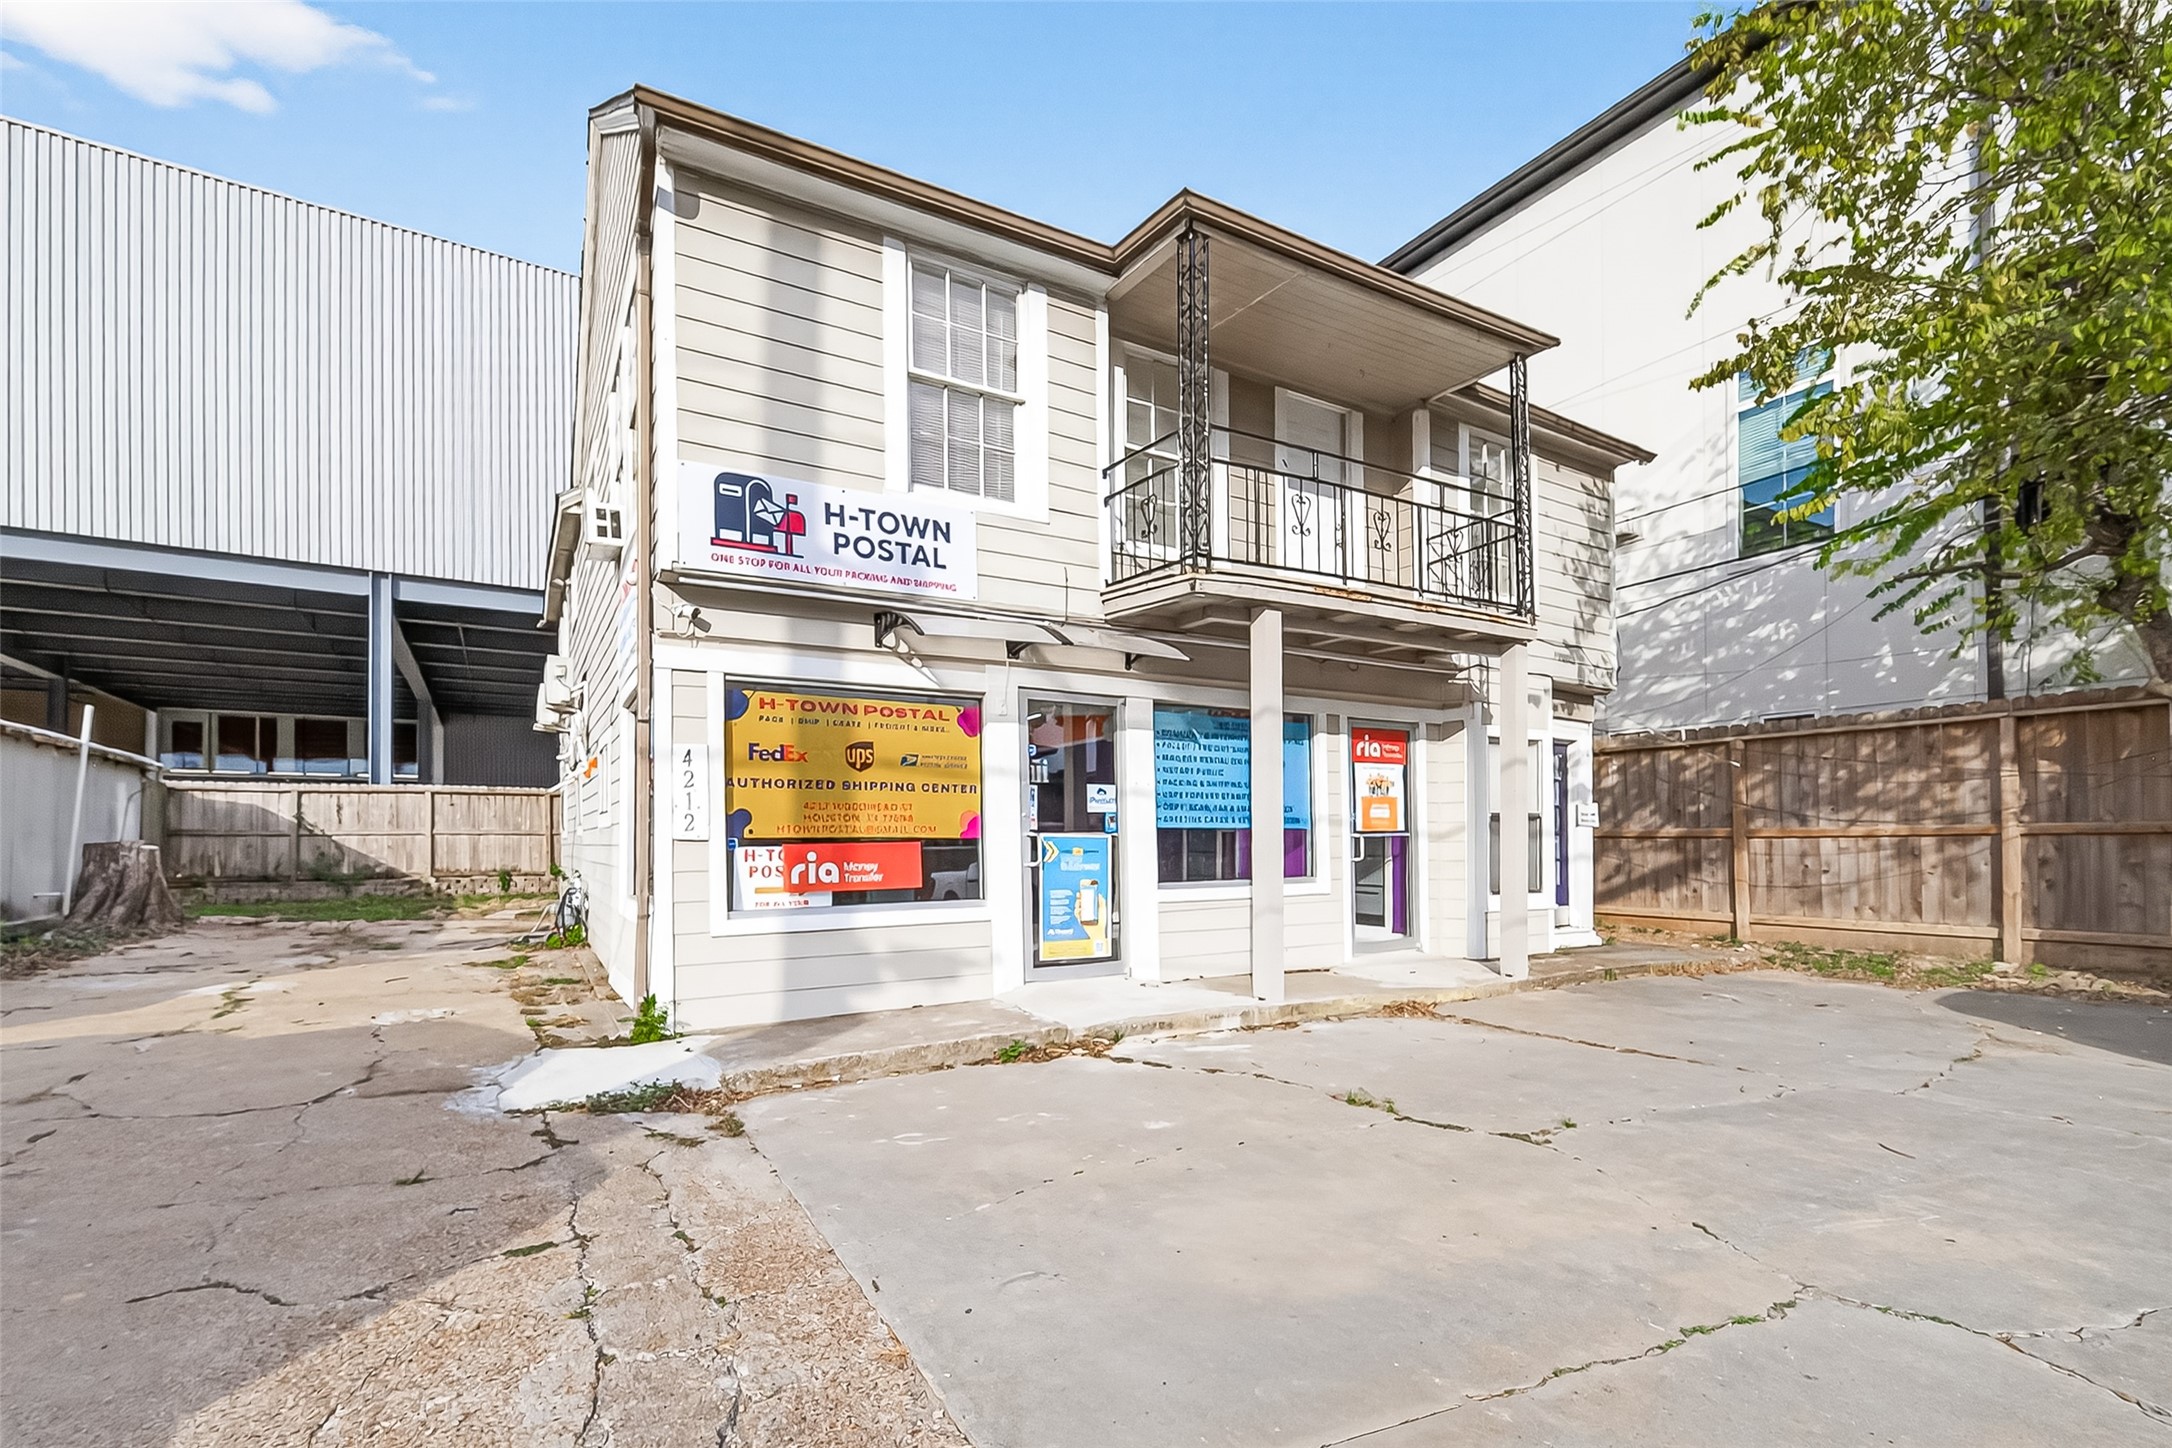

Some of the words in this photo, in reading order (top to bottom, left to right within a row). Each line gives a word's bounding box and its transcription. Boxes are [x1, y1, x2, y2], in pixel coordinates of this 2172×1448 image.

[824, 502, 951, 544] H-TOWN
[833, 532, 947, 570] POSTAL
[711, 553, 734, 564] ONE
[738, 556, 766, 568] STOP
[769, 560, 790, 571] FOR
[793, 563, 811, 574] ALL
[814, 566, 842, 578] YOUR
[759, 697, 858, 715] H-TOWN
[864, 705, 950, 721] POSTAL
[749, 743, 808, 762] FedEx
[1356, 734, 1381, 758] ria
[682, 748, 695, 832] 4212
[727, 778, 835, 790] AUTHORIZED
[842, 781, 915, 792] SHIPPING
[922, 783, 977, 794] CENTER
[803, 813, 860, 822] HOUSTON
[790, 851, 840, 884] ria
[843, 862, 879, 872] Money
[844, 874, 884, 883] Transfer
